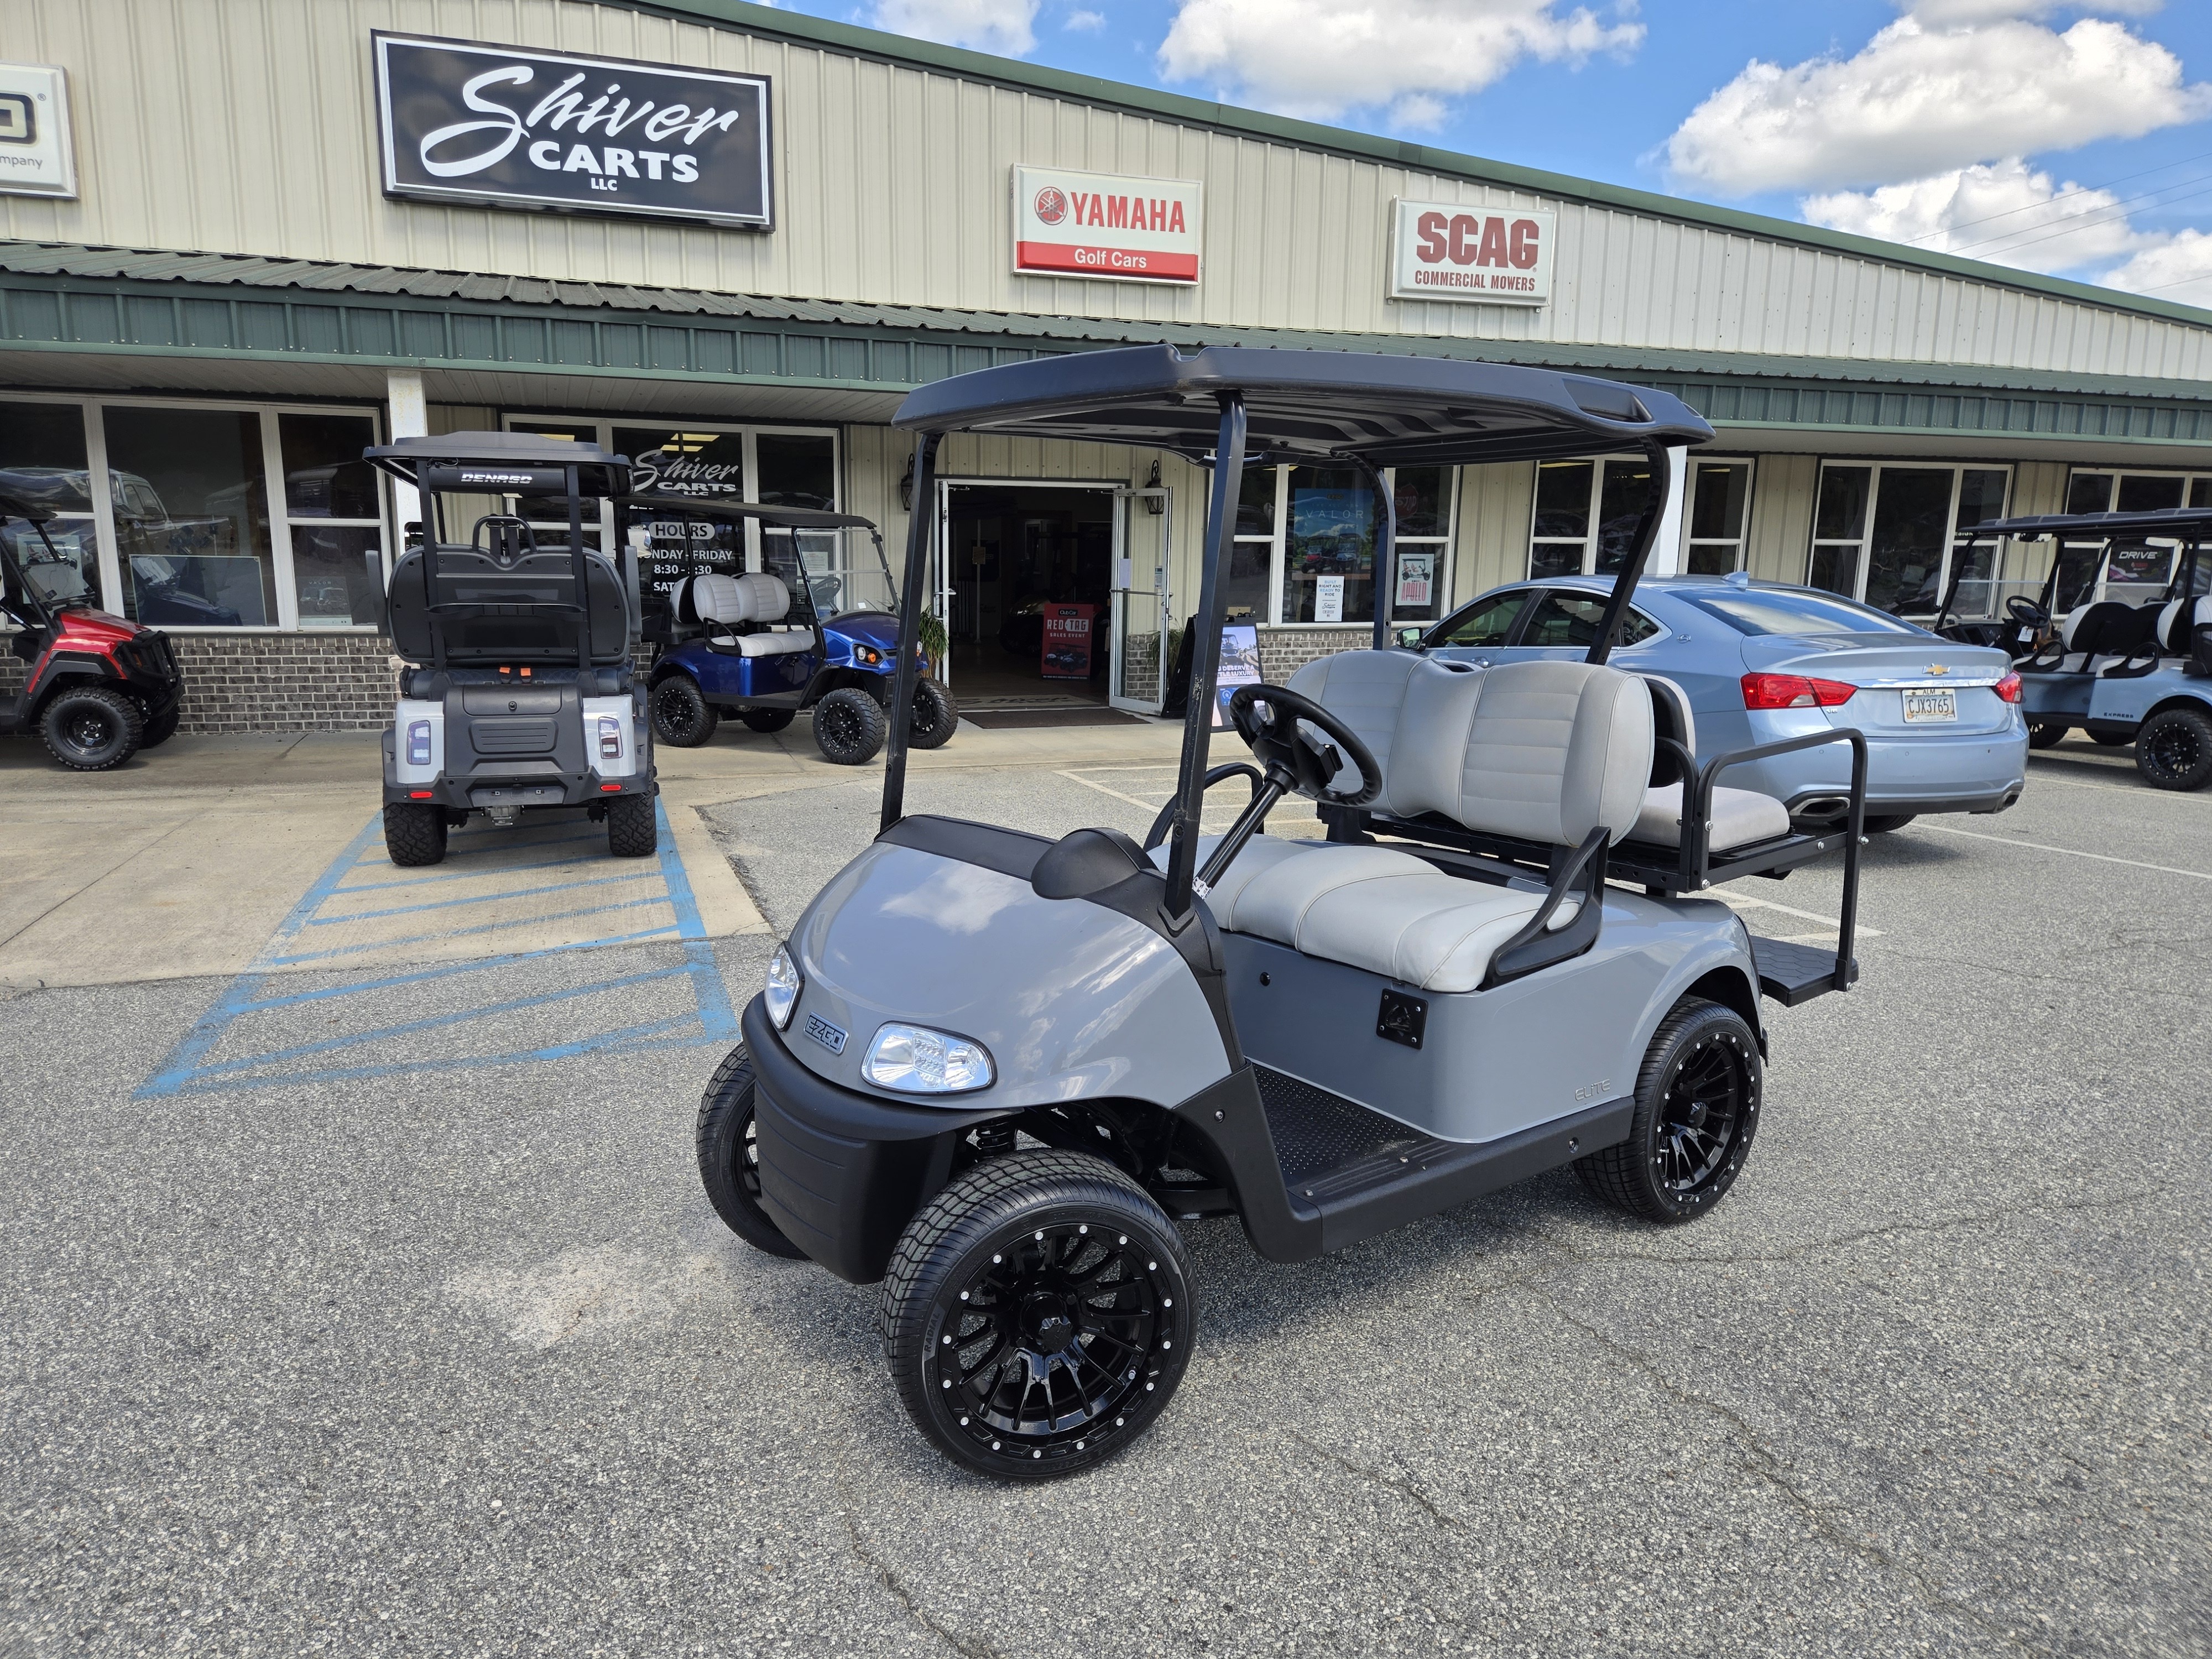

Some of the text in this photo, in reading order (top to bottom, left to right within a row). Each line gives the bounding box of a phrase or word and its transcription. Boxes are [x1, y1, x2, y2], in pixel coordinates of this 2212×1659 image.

[420, 65, 739, 176] Shiver
[529, 140, 700, 183] CARTS
[591, 178, 618, 191] LLC
[1071, 192, 1186, 233] YAMAHA
[1416, 211, 1540, 270] SCAG
[1074, 248, 1147, 269] Golf Cars
[1415, 270, 1535, 291] COMMERCIAL MOWERS
[634, 449, 739, 492] Shiver
[657, 482, 737, 492] CARTS
[1306, 509, 1364, 519] VALOR
[655, 524, 708, 537] HOURS
[692, 550, 733, 561] FRIDAY
[2119, 551, 2158, 559] DRIVE
[654, 565, 679, 575] 8:30
[687, 565, 712, 575] :30
[1401, 582, 1427, 602] APOLLO
[1047, 619, 1086, 630] RED TAG
[1908, 698, 1949, 714] CJX3765
[805, 1016, 844, 1050] EZGO
[924, 1312, 940, 1353] RADIAL
